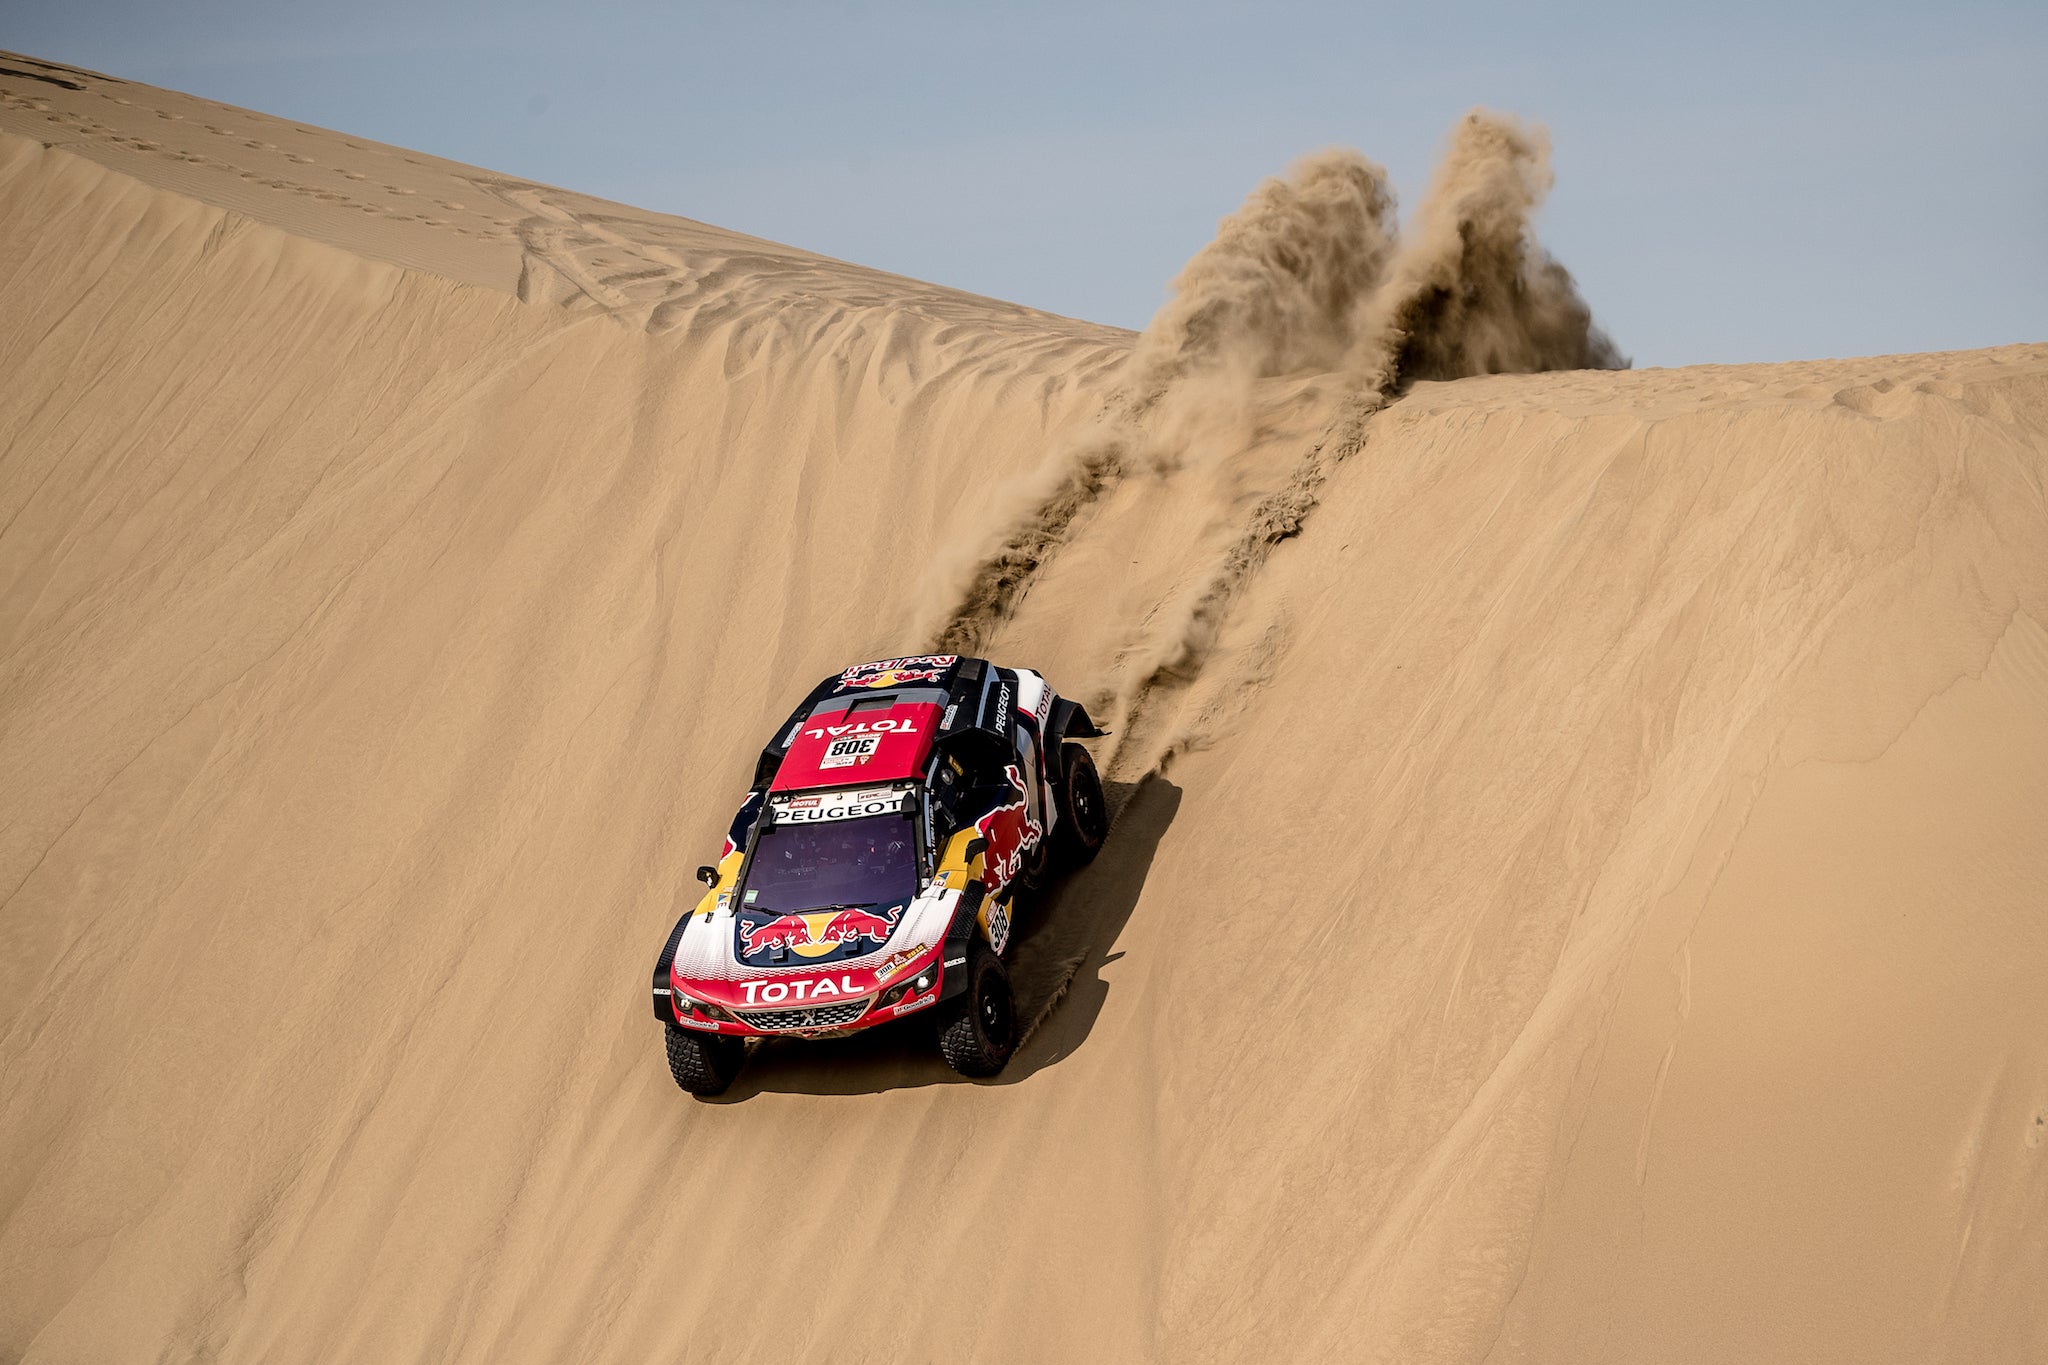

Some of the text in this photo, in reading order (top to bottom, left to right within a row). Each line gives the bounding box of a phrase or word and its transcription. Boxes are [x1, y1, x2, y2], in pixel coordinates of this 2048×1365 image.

[899, 655, 958, 669] Red
[995, 683, 1012, 734] PEUGEOT
[805, 719, 918, 739] TOTAL
[831, 739, 875, 756] 308
[774, 799, 902, 822] PEUGEOT
[791, 798, 819, 808] MOTUL
[991, 905, 1008, 949] 308
[878, 963, 893, 977] 308
[739, 975, 865, 1004] TOTAL
